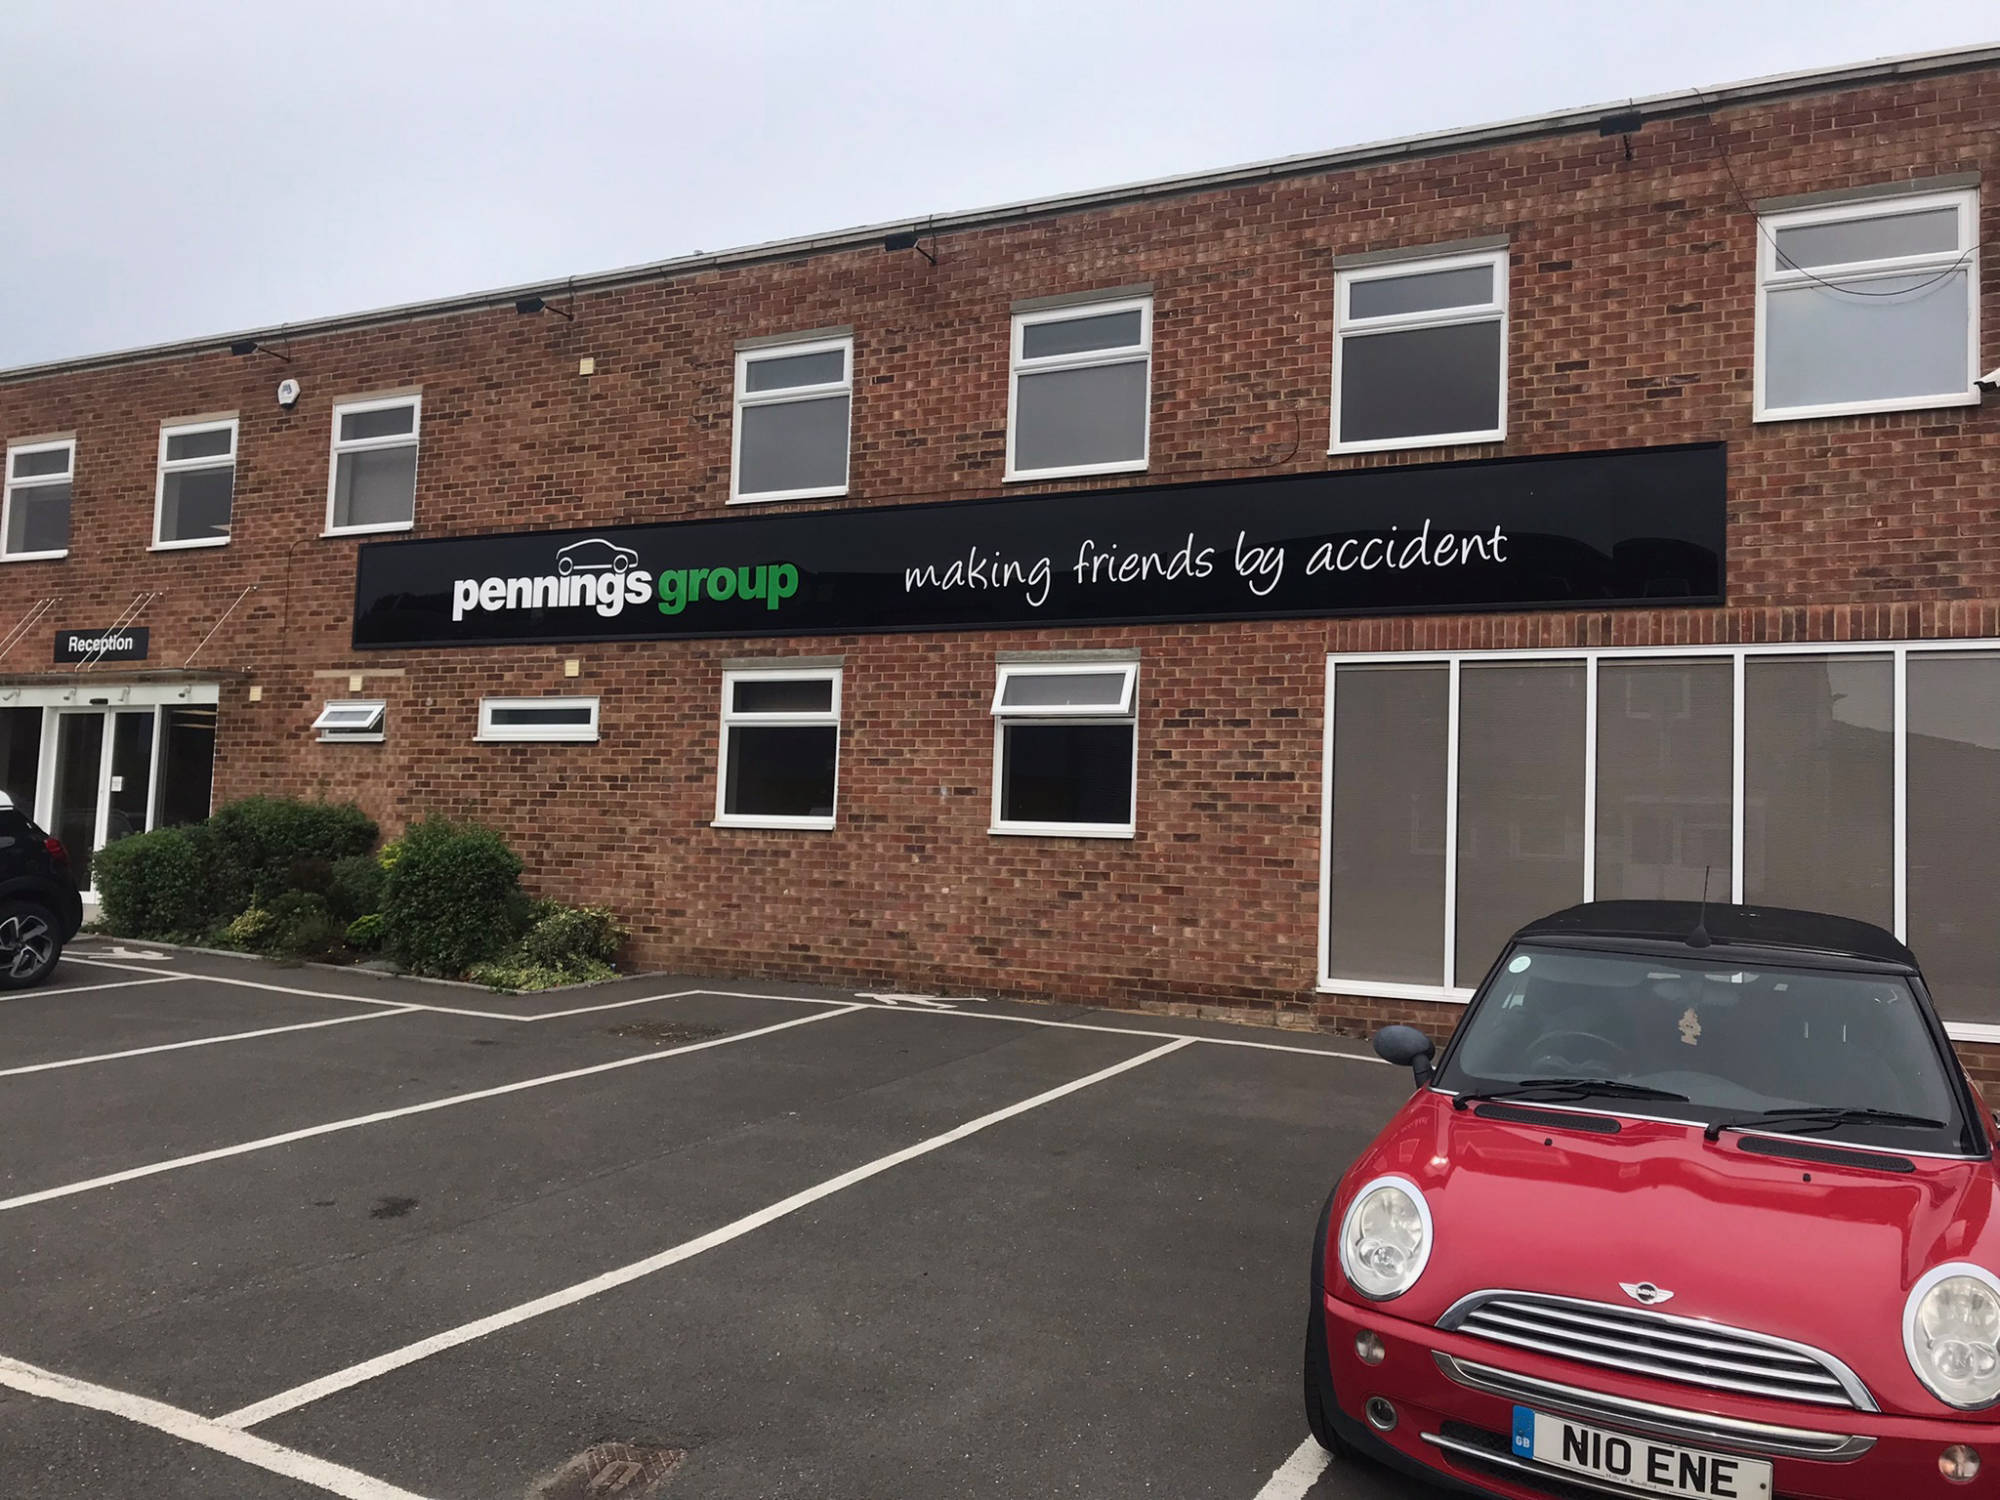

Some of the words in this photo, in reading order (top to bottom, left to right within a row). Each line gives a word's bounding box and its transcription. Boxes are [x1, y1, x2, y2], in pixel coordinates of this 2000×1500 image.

[905, 546, 1051, 606] making
[1073, 532, 1216, 584] friends
[1235, 530, 1285, 596] by
[1306, 518, 1508, 575] accident
[452, 569, 653, 621] pennings
[658, 562, 799, 615] group
[68, 634, 133, 655] Reception
[1515, 1435, 1531, 1449] GB
[1647, 1446, 1739, 1498] ENE
